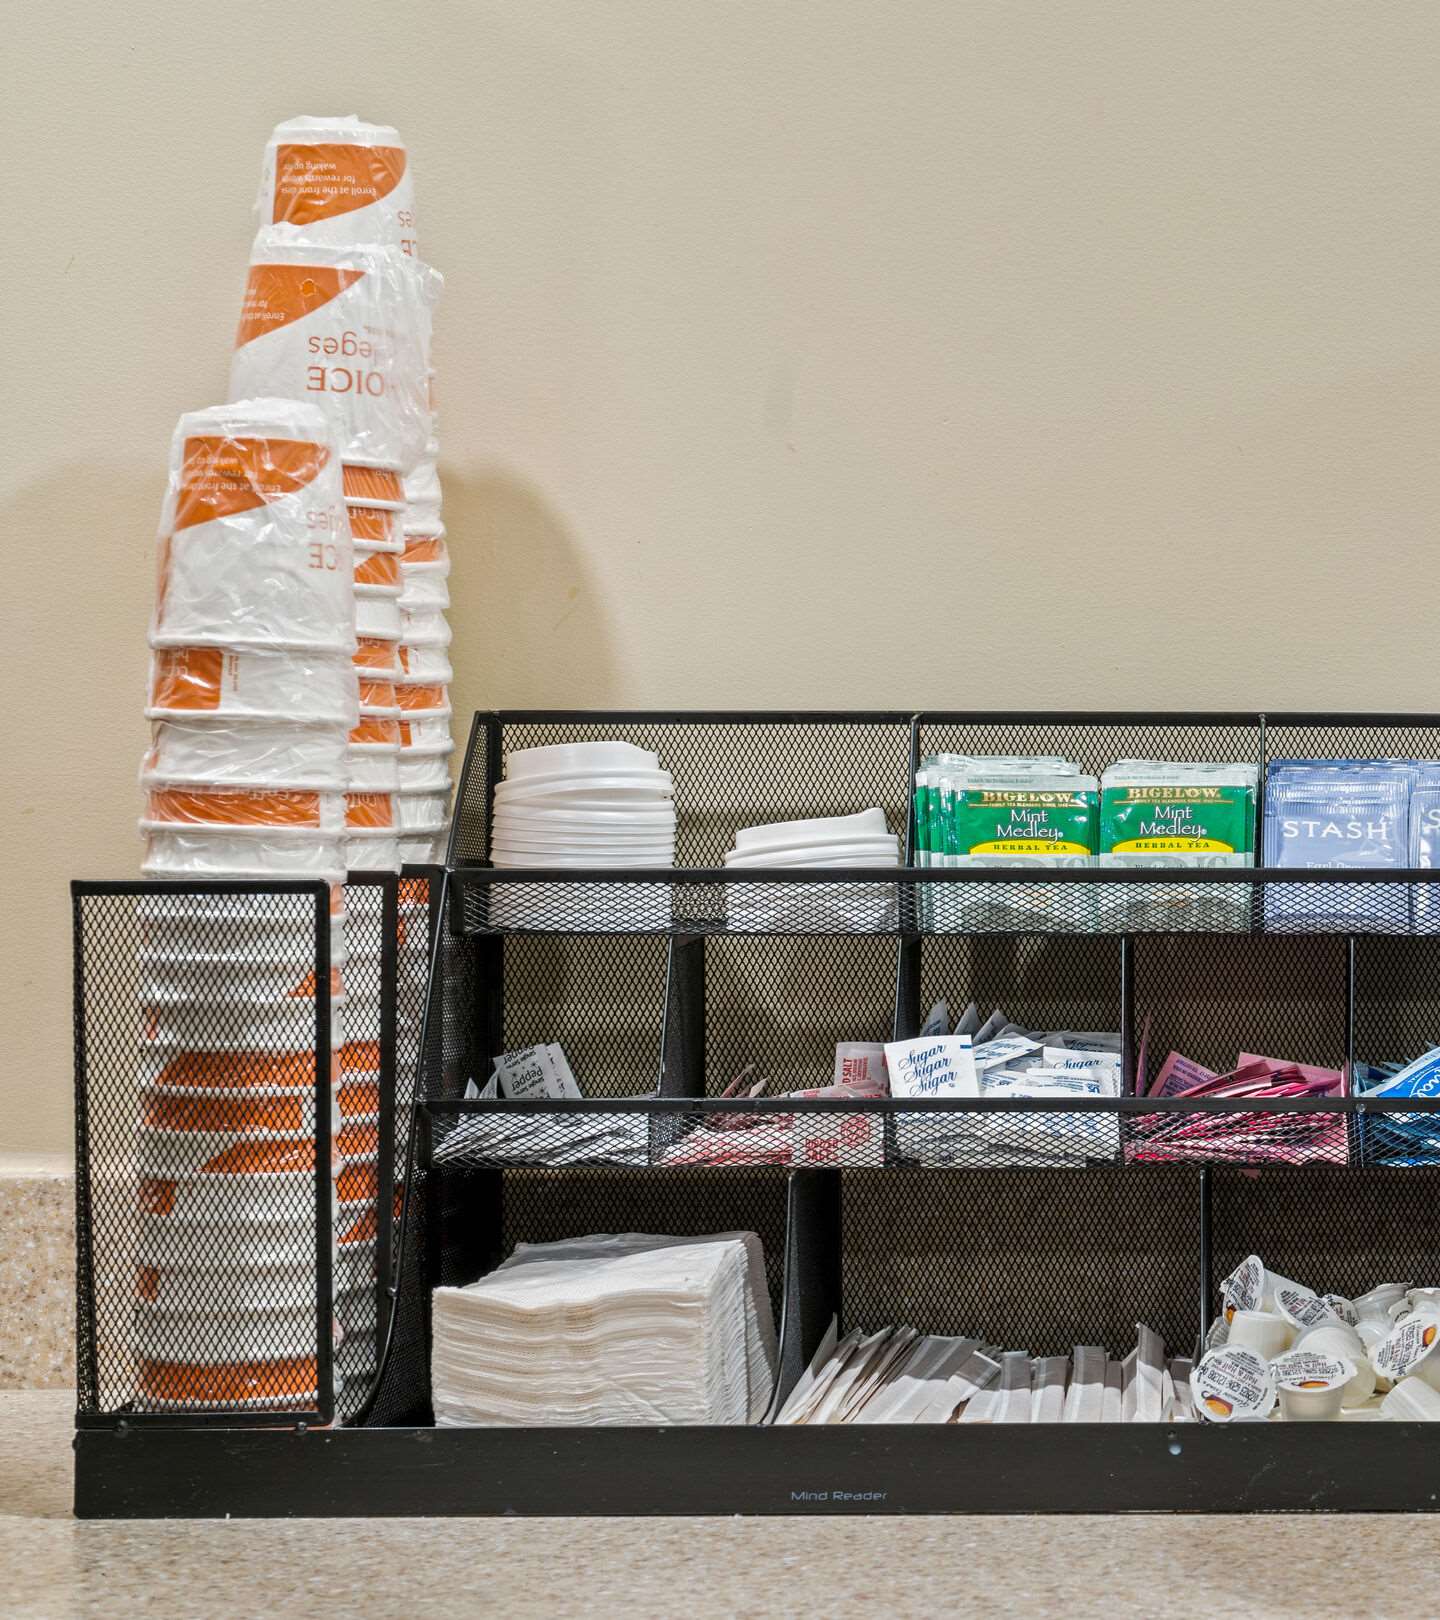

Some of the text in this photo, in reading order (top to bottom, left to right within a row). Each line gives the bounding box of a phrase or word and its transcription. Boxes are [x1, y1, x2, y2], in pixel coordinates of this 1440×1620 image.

[305, 161, 337, 171] waking
[341, 175, 356, 183] for
[323, 186, 337, 195] the
[339, 186, 349, 194] at
[351, 186, 377, 196] Enroll
[983, 791, 1072, 802] BIGELOW
[1127, 787, 1221, 799] BIGELOW
[1010, 809, 1049, 823] Mint
[1154, 805, 1193, 819] Mint
[1282, 820, 1388, 840] STASH
[993, 843, 1069, 851] HERBAL TEA
[1135, 841, 1211, 849] HERBAL TEA
[898, 1044, 948, 1070] Sugar
[843, 1058, 853, 1077] SALT
[903, 1057, 952, 1084] Sugar
[511, 1066, 544, 1092] Pepper
[909, 1071, 958, 1097] Sugar
[791, 1491, 888, 1501] Mind Reader
